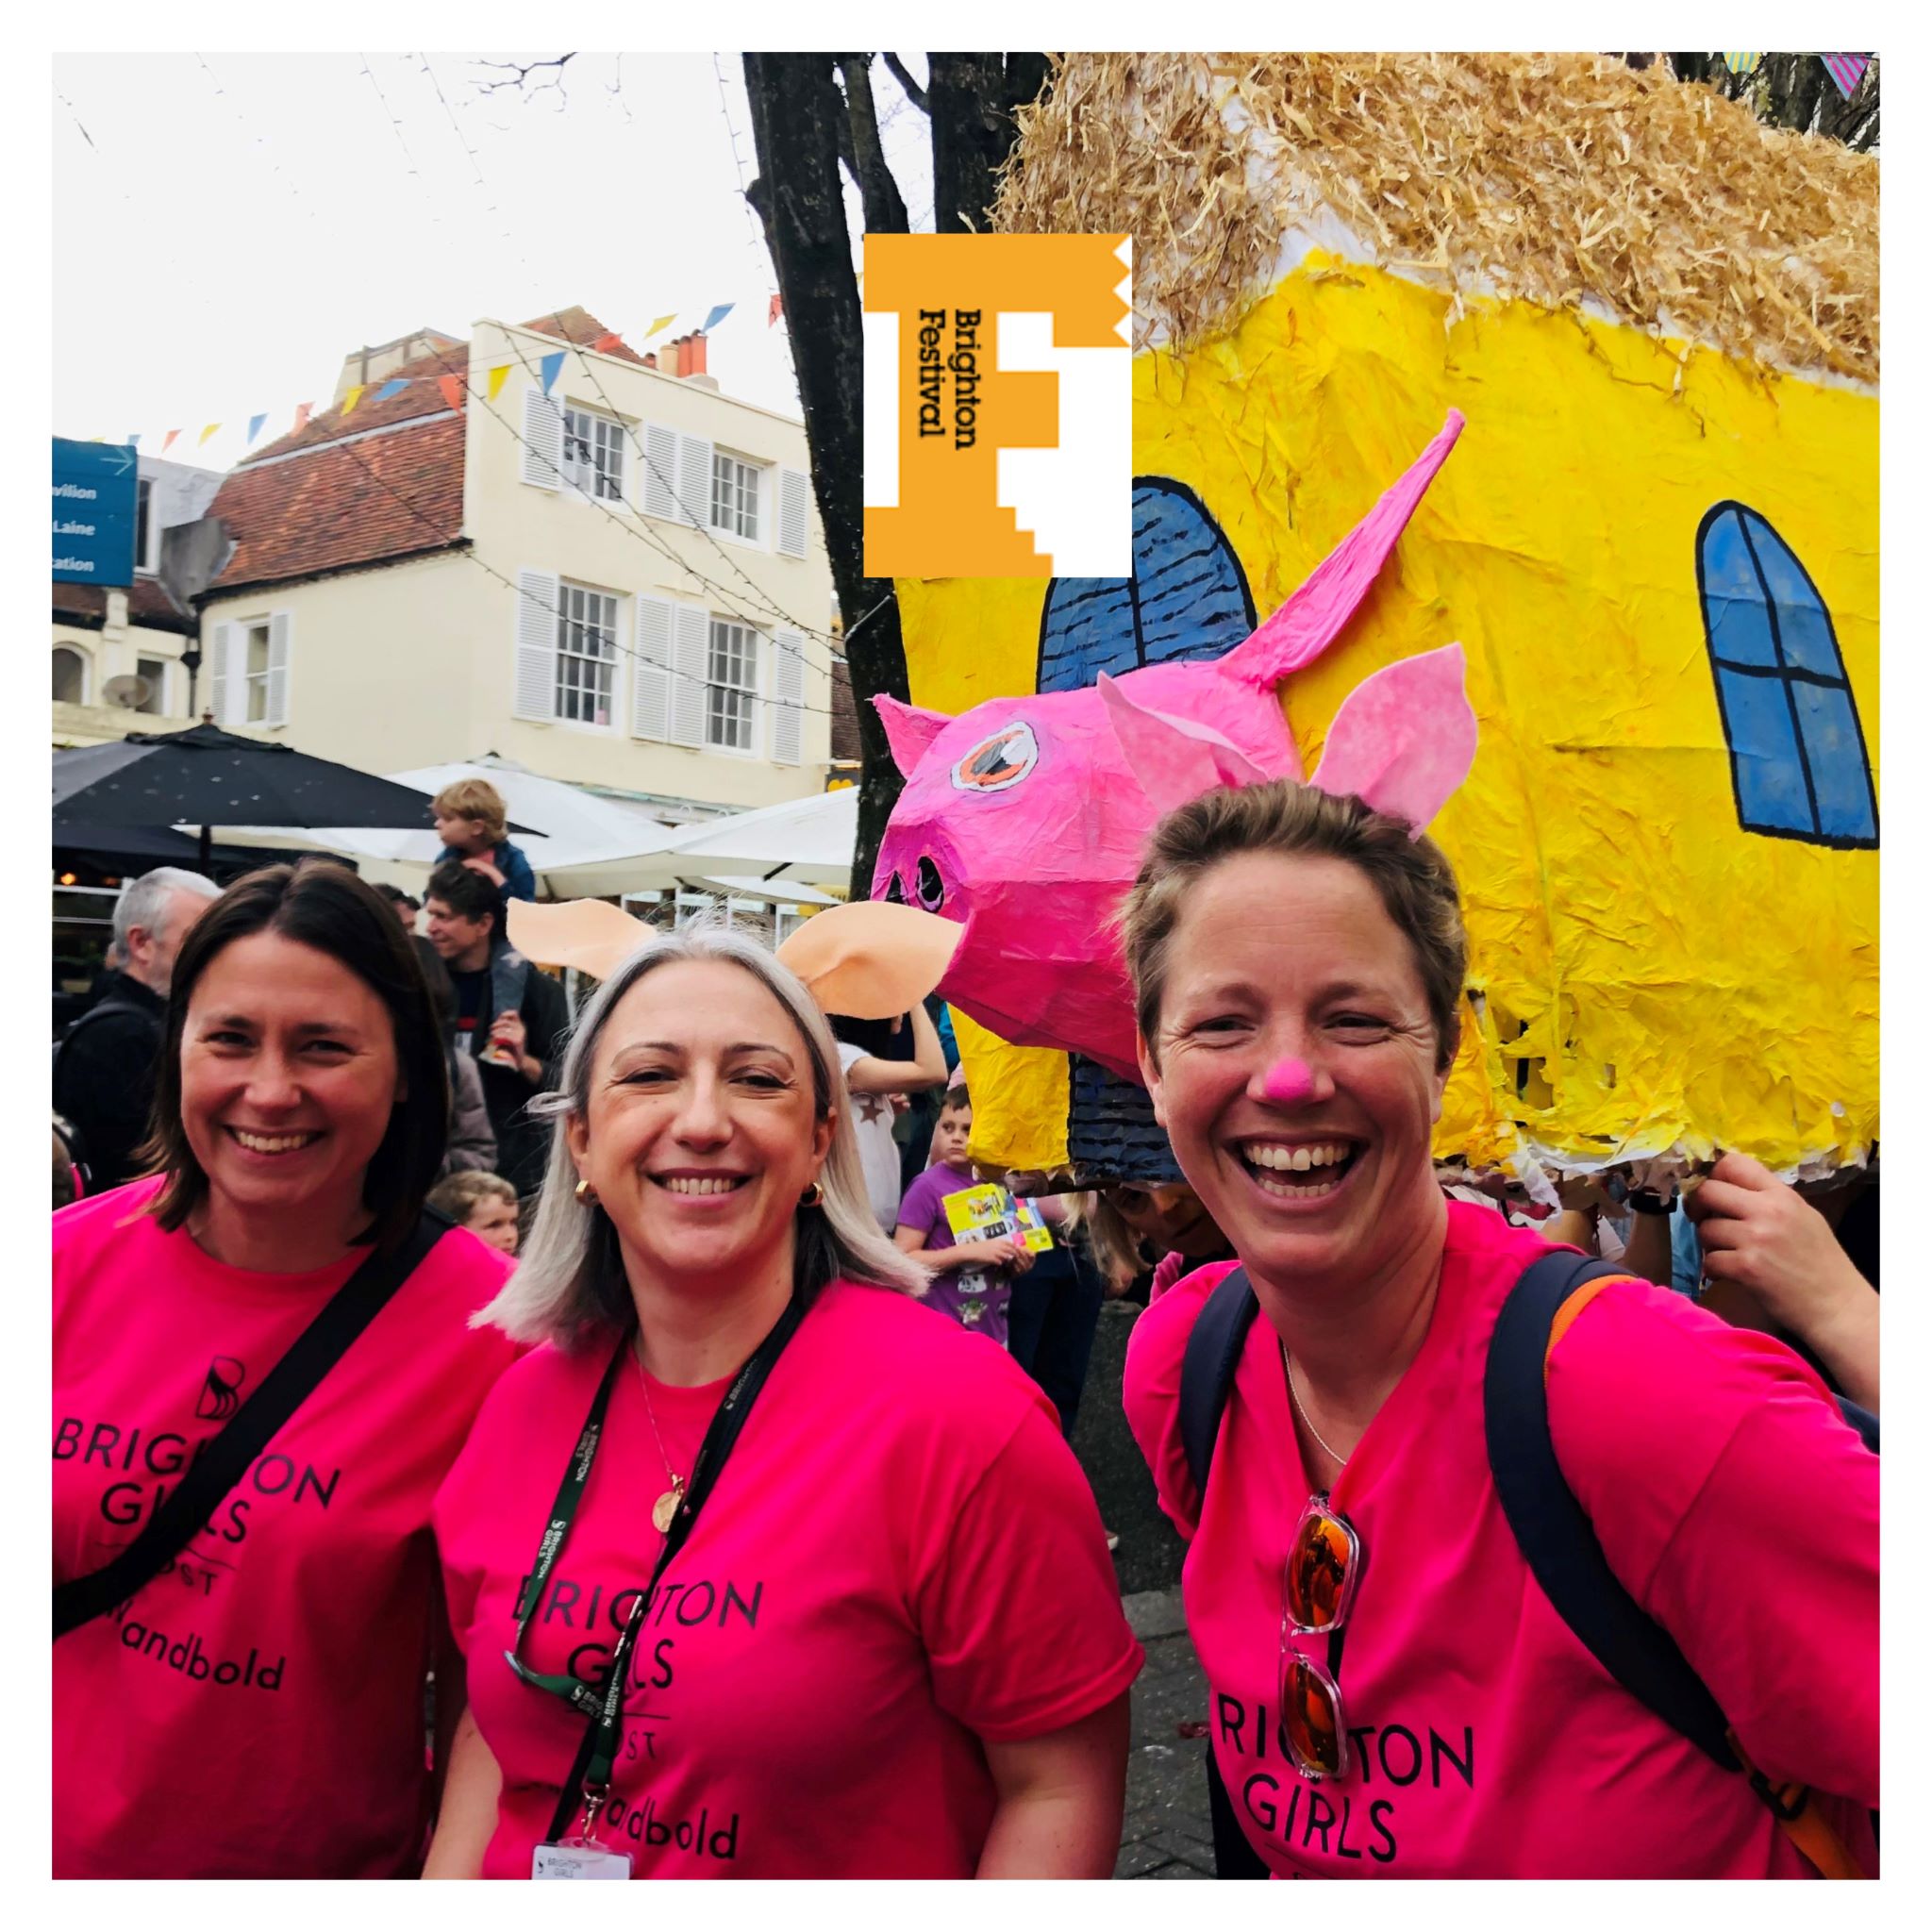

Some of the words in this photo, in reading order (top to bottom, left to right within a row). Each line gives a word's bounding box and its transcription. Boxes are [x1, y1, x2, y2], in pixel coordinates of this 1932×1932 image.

[52, 483, 96, 500] vilion
[53, 520, 95, 536] Laine
[52, 557, 94, 572] ation
[52, 1418, 341, 1509] BRIGON
[538, 1530, 563, 1579] BRIGHTON
[1217, 1692, 1474, 1790] RITON
[1242, 1774, 1397, 1863] GIRLS
